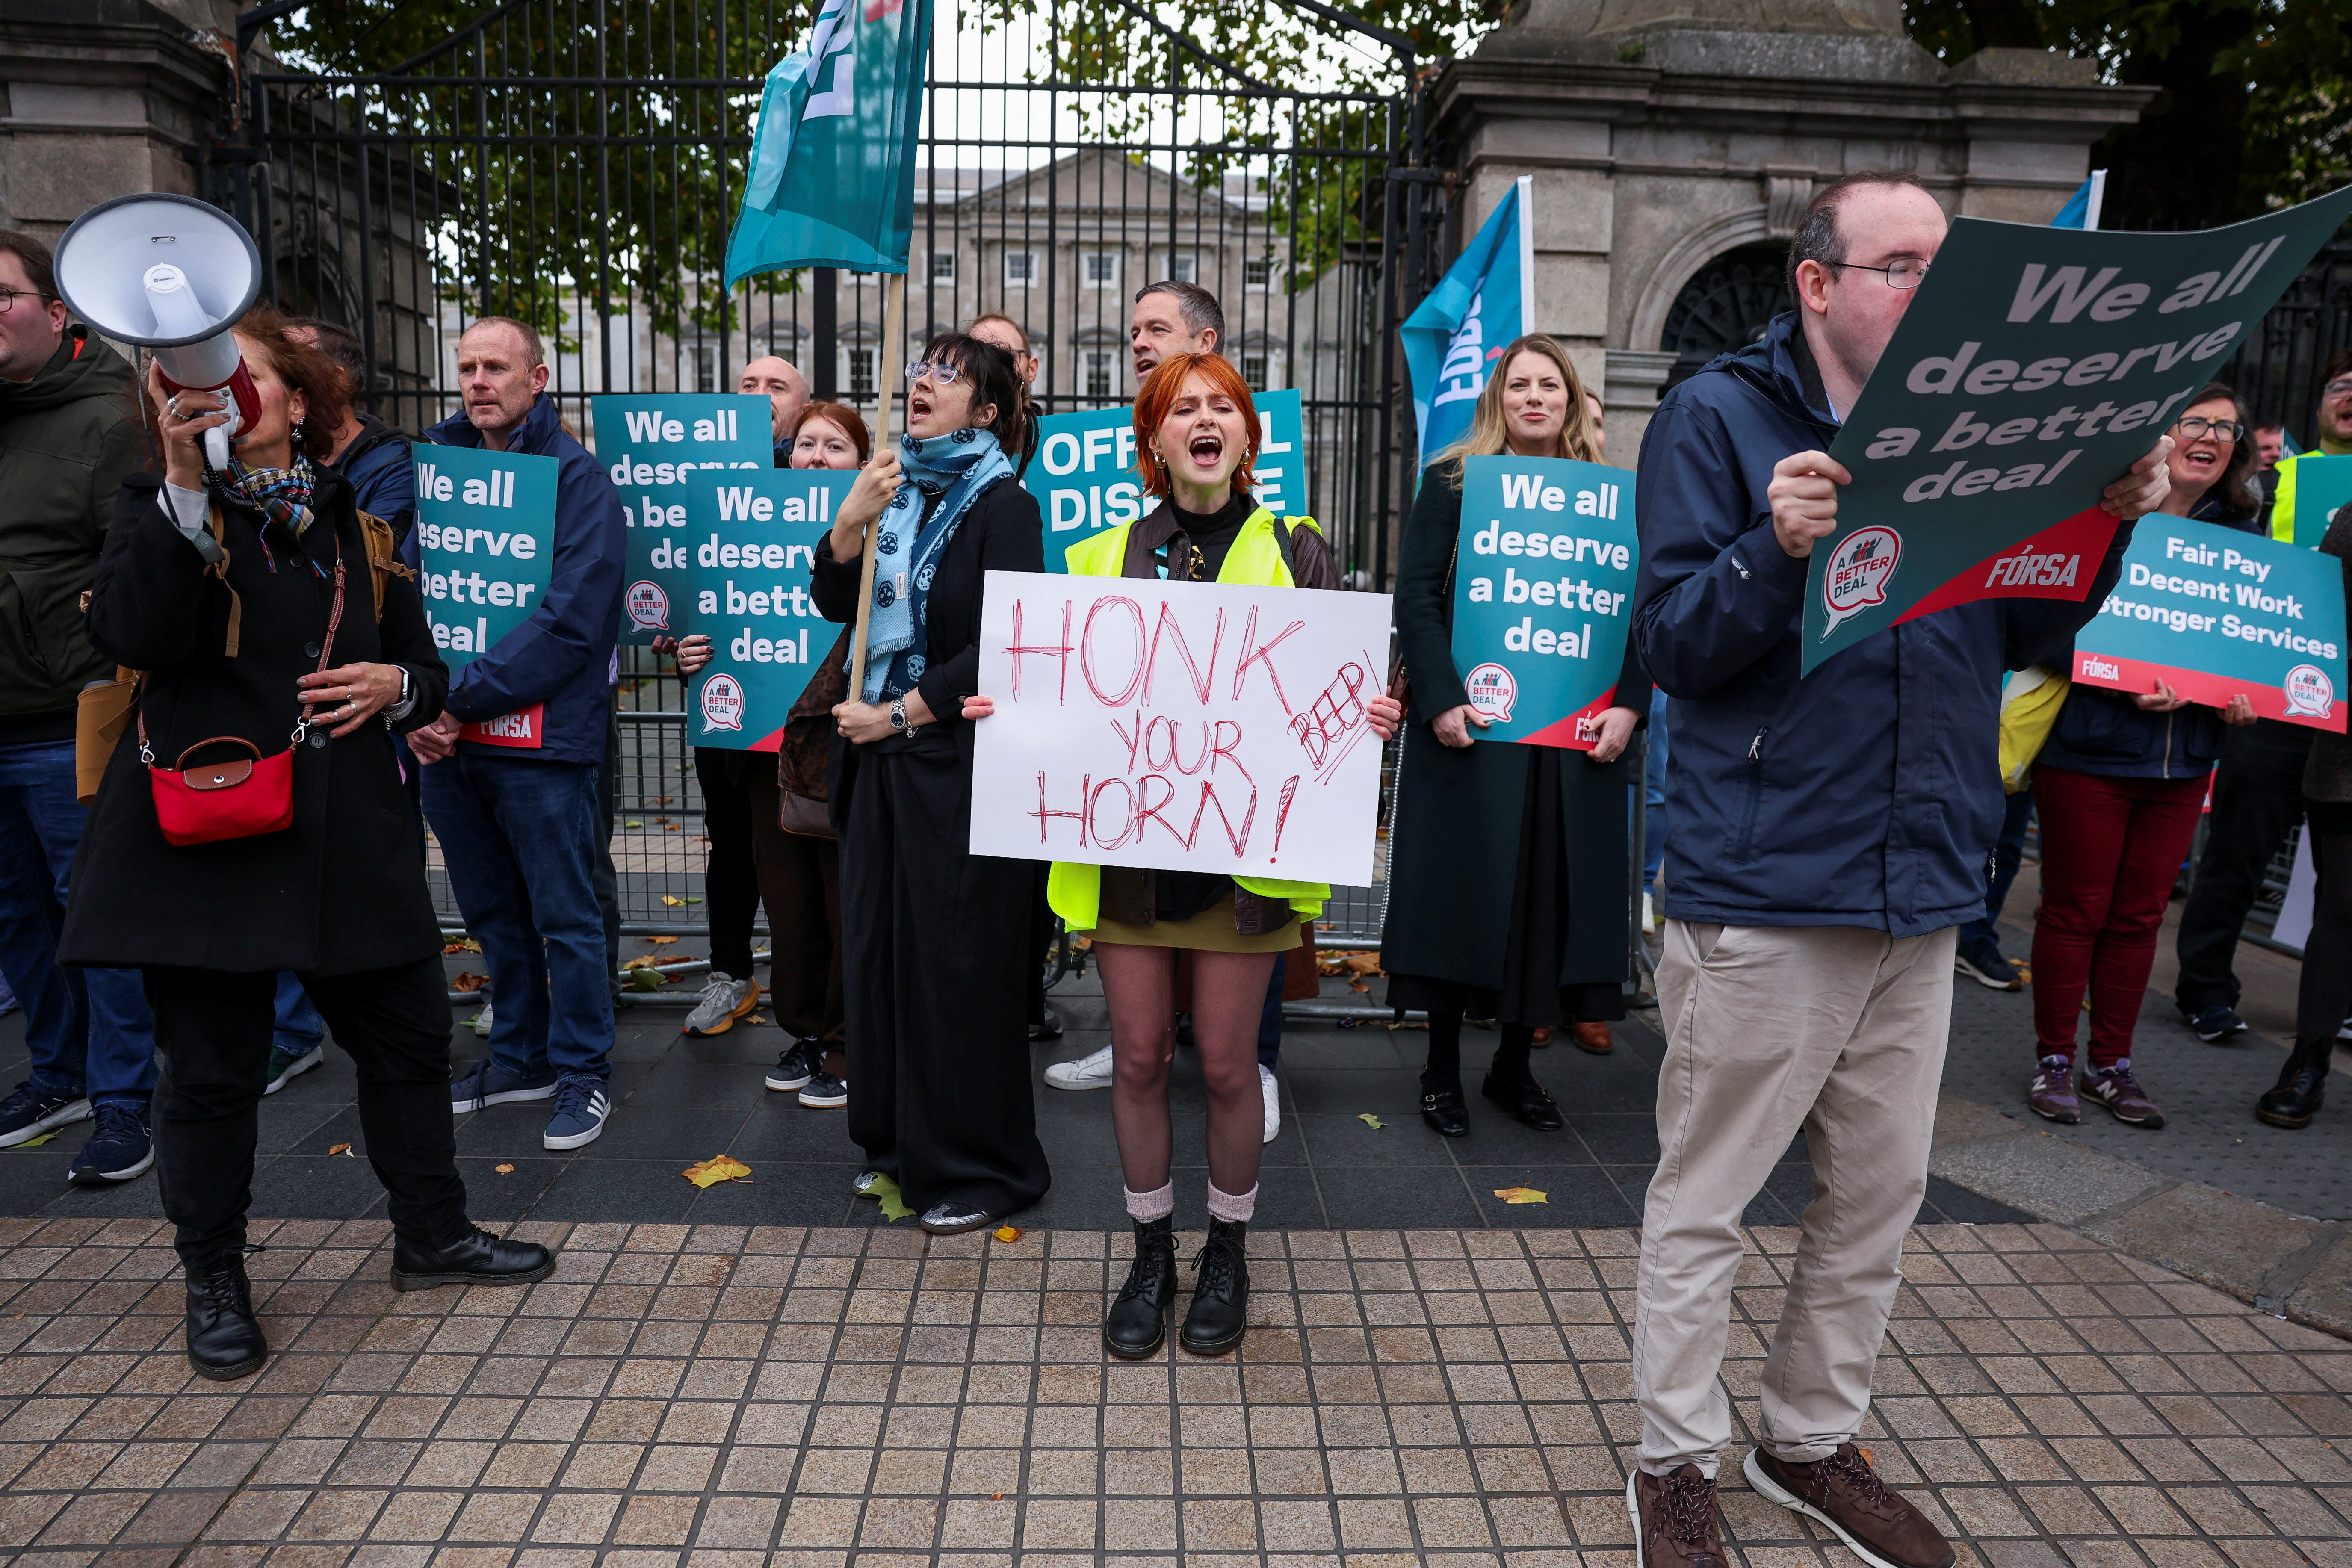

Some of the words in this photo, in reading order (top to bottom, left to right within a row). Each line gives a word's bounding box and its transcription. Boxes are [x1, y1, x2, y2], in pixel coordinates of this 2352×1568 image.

[2006, 263, 2151, 323] We
[2158, 235, 2286, 314] all
[1906, 322, 2242, 395] deserve
[624, 411, 684, 443] We
[693, 410, 738, 442] all
[1042, 411, 1292, 476] OFFL
[1865, 428, 1921, 460] a
[1930, 386, 2194, 453] better
[418, 462, 453, 502] We
[462, 470, 515, 508] all
[1501, 474, 1566, 511] We
[1574, 482, 1619, 520] all
[1903, 449, 2083, 502] deal
[717, 487, 773, 522] We
[782, 487, 829, 522] all
[1050, 467, 1286, 532] DISE
[1473, 520, 1630, 570] deserve
[1836, 557, 1845, 571] A
[1985, 544, 2080, 588] FÓRSA
[2166, 536, 2219, 567] Fair
[2223, 548, 2272, 584] Pay
[421, 559, 535, 608] better
[1469, 577, 1493, 602] a
[1503, 567, 1625, 617] better
[1834, 576, 1867, 599] DEAL
[1835, 556, 1890, 585] BETTER
[2129, 563, 2230, 603] Decent
[2235, 584, 2304, 620] Work
[698, 590, 717, 614] a
[726, 580, 823, 617] bett
[731, 627, 808, 664] deal
[1001, 596, 1305, 717] HONK
[1504, 616, 1591, 659] deal
[2221, 614, 2339, 660] Services
[1474, 687, 1509, 696] BETTER
[2082, 656, 2119, 681] FÓRSA
[2296, 684, 2327, 696] BETTER
[709, 697, 738, 706] BETTER
[1473, 696, 1496, 704] DEAL
[2295, 691, 2317, 701] DEAL
[1111, 709, 1256, 789] YOUR
[1027, 770, 1300, 864] HORN!
